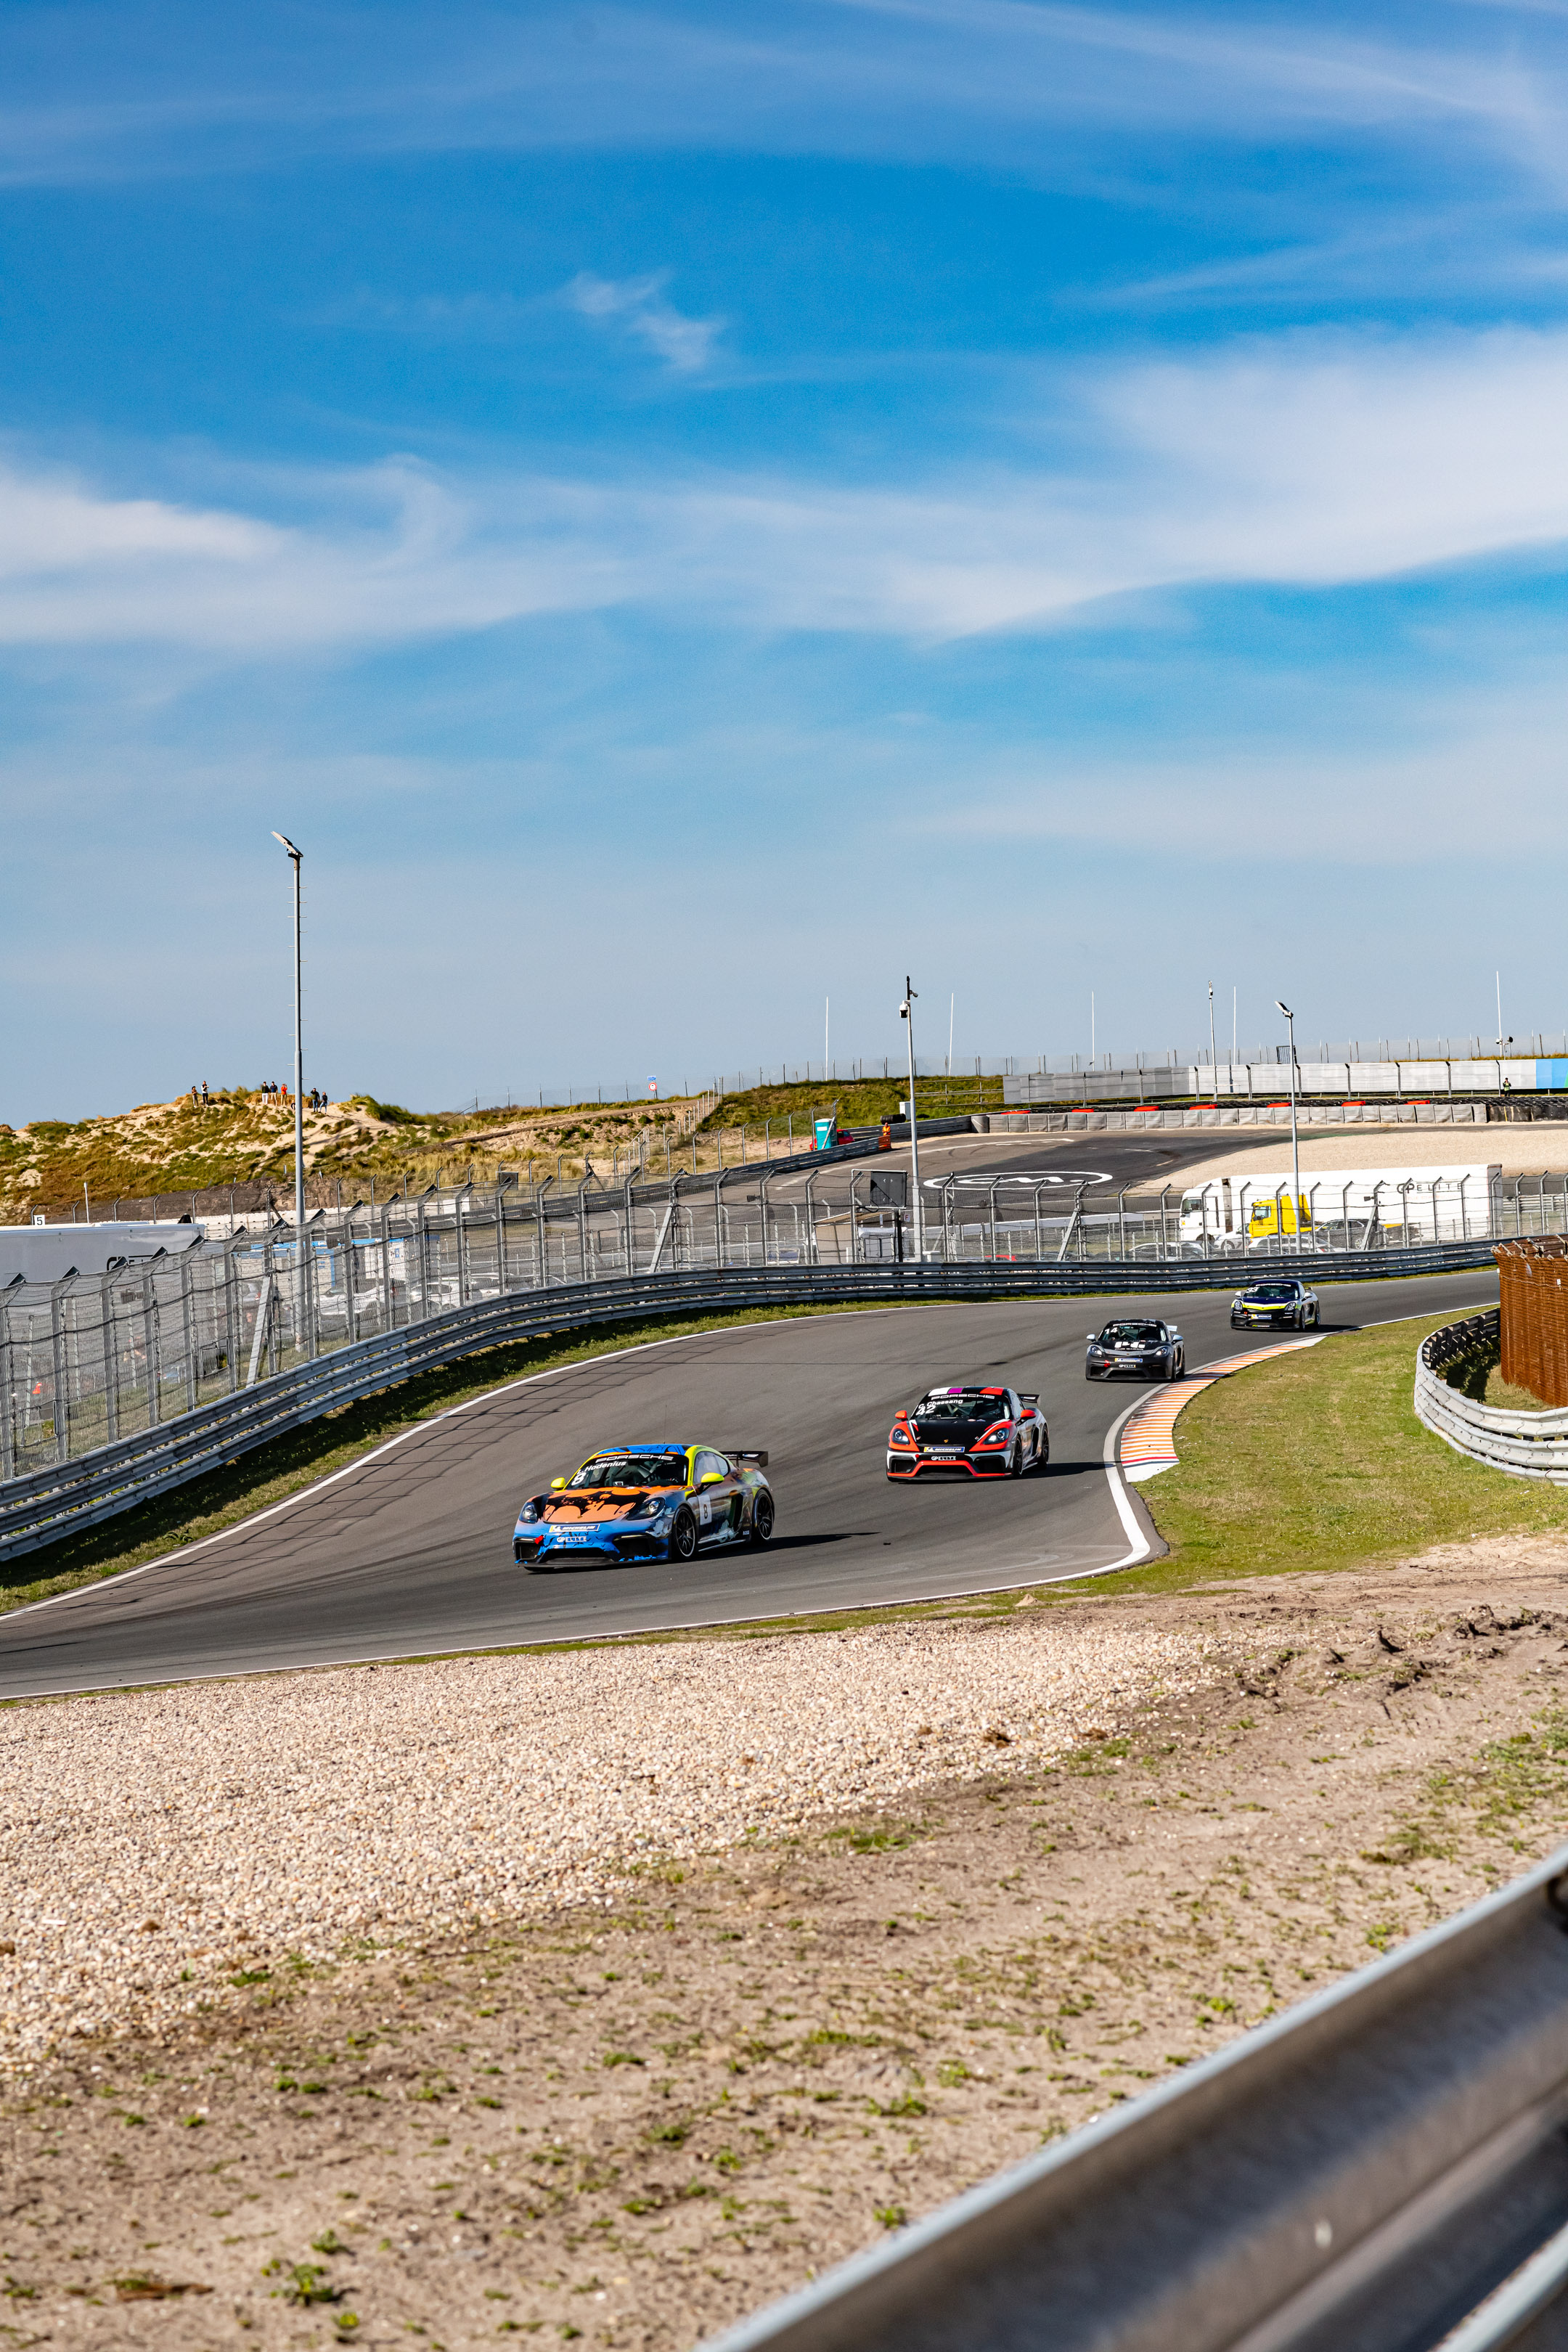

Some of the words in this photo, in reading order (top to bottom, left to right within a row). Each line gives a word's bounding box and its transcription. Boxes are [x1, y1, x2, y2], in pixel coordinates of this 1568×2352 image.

[36, 1217, 42, 1225] 5
[915, 1405, 936, 1416] 42
[595, 1454, 674, 1463] PORSCHE
[571, 1472, 585, 1486] 8
[703, 1503, 709, 1519] 8
